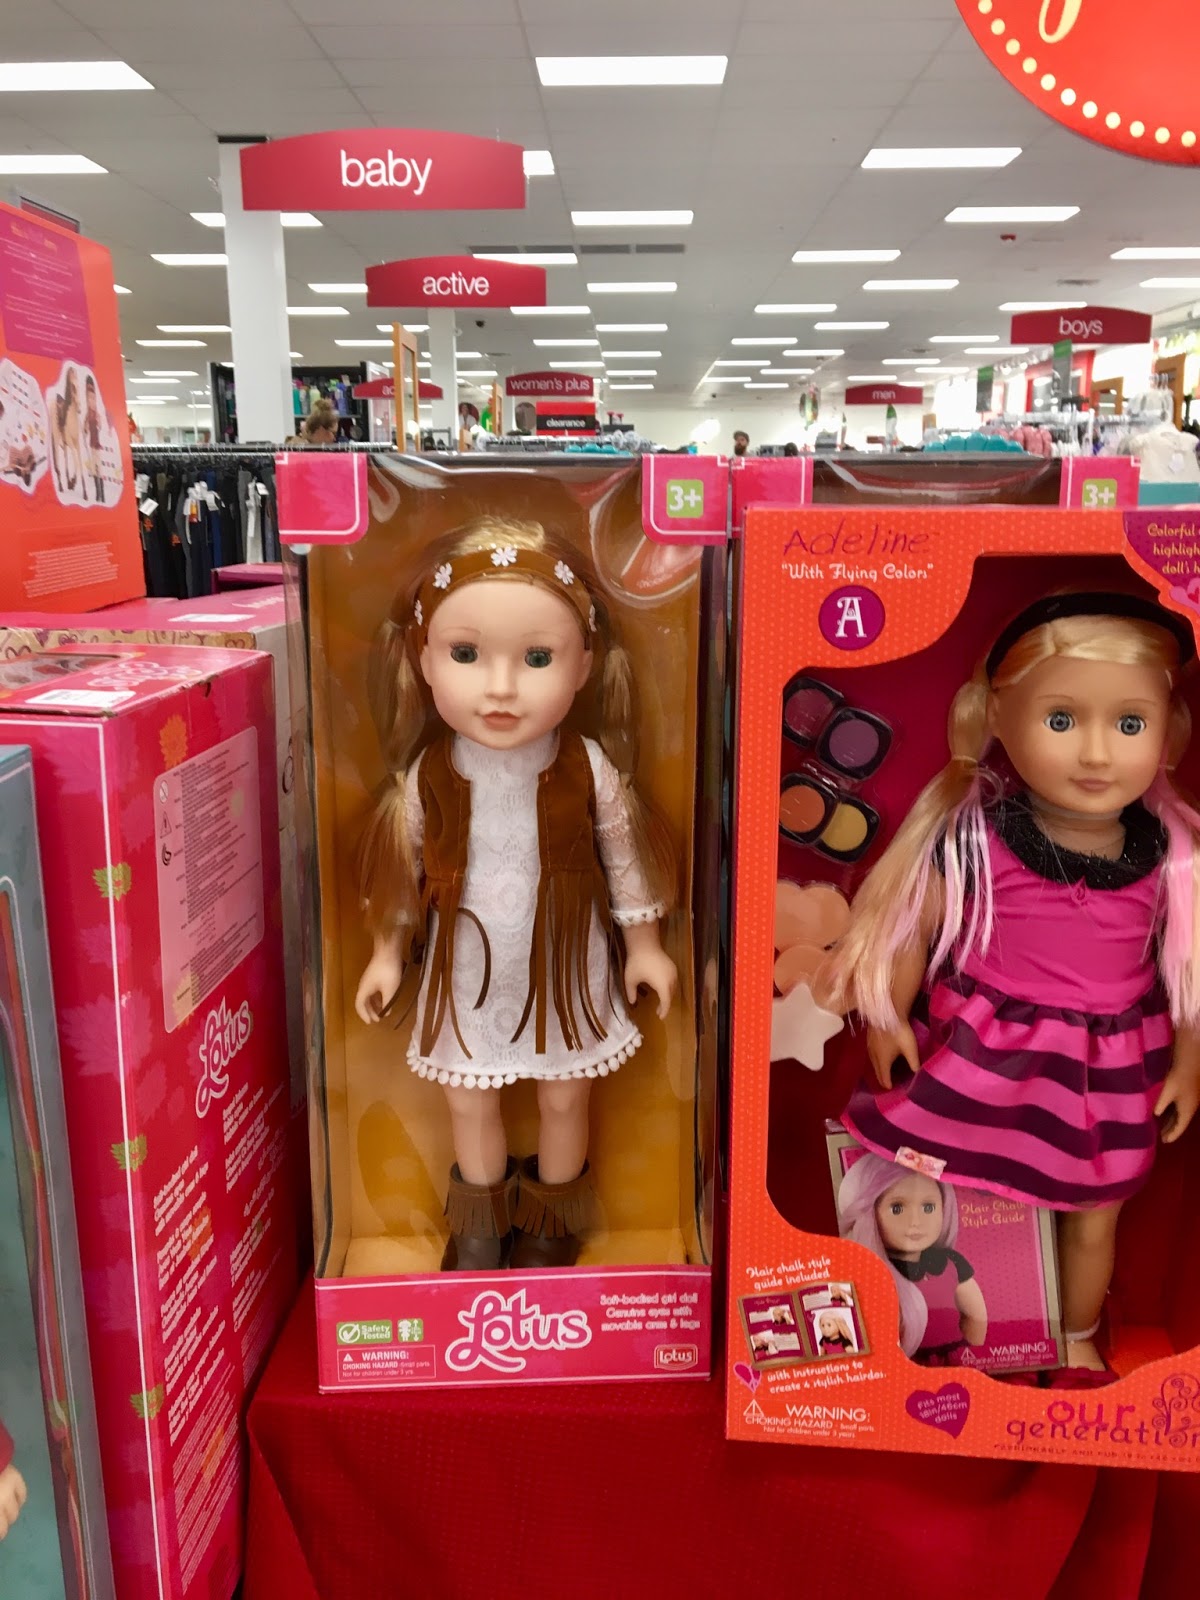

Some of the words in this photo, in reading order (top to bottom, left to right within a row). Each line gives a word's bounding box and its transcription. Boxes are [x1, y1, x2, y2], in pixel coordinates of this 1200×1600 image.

[340, 149, 433, 195] baby
[422, 271, 490, 296] active
[1058, 316, 1103, 338] boys
[510, 378, 563, 391] women's
[565, 378, 591, 392] plus
[871, 390, 896, 400] men
[546, 418, 586, 428] clearance
[669, 485, 702, 511] 3+
[1083, 483, 1115, 510] 3+
[783, 518, 931, 556] Adeline
[1147, 522, 1195, 540] Colorful
[829, 562, 878, 583] Flying
[835, 596, 868, 638] A
[195, 995, 252, 1119] Lotus
[961, 1215, 989, 1229] Style
[991, 1212, 1026, 1225] Guide
[776, 1259, 806, 1274] chalk
[753, 1275, 783, 1292] guide
[785, 1267, 831, 1285] included
[361, 1324, 390, 1333] Safety
[363, 1331, 391, 1340] Tested
[444, 1288, 593, 1373] Lotus
[361, 1350, 409, 1361] WARNING:
[342, 1362, 371, 1371] CHOKING
[372, 1361, 399, 1369] HAZARD
[767, 1369, 791, 1383] with
[793, 1363, 850, 1377] instructions
[852, 1360, 863, 1370] to
[769, 1382, 801, 1394] create
[936, 1392, 961, 1403] most
[745, 1416, 791, 1426] CHOKING
[793, 1419, 833, 1429] HAZARD
[934, 1412, 958, 1424] dolls
[1047, 1400, 1136, 1429] our
